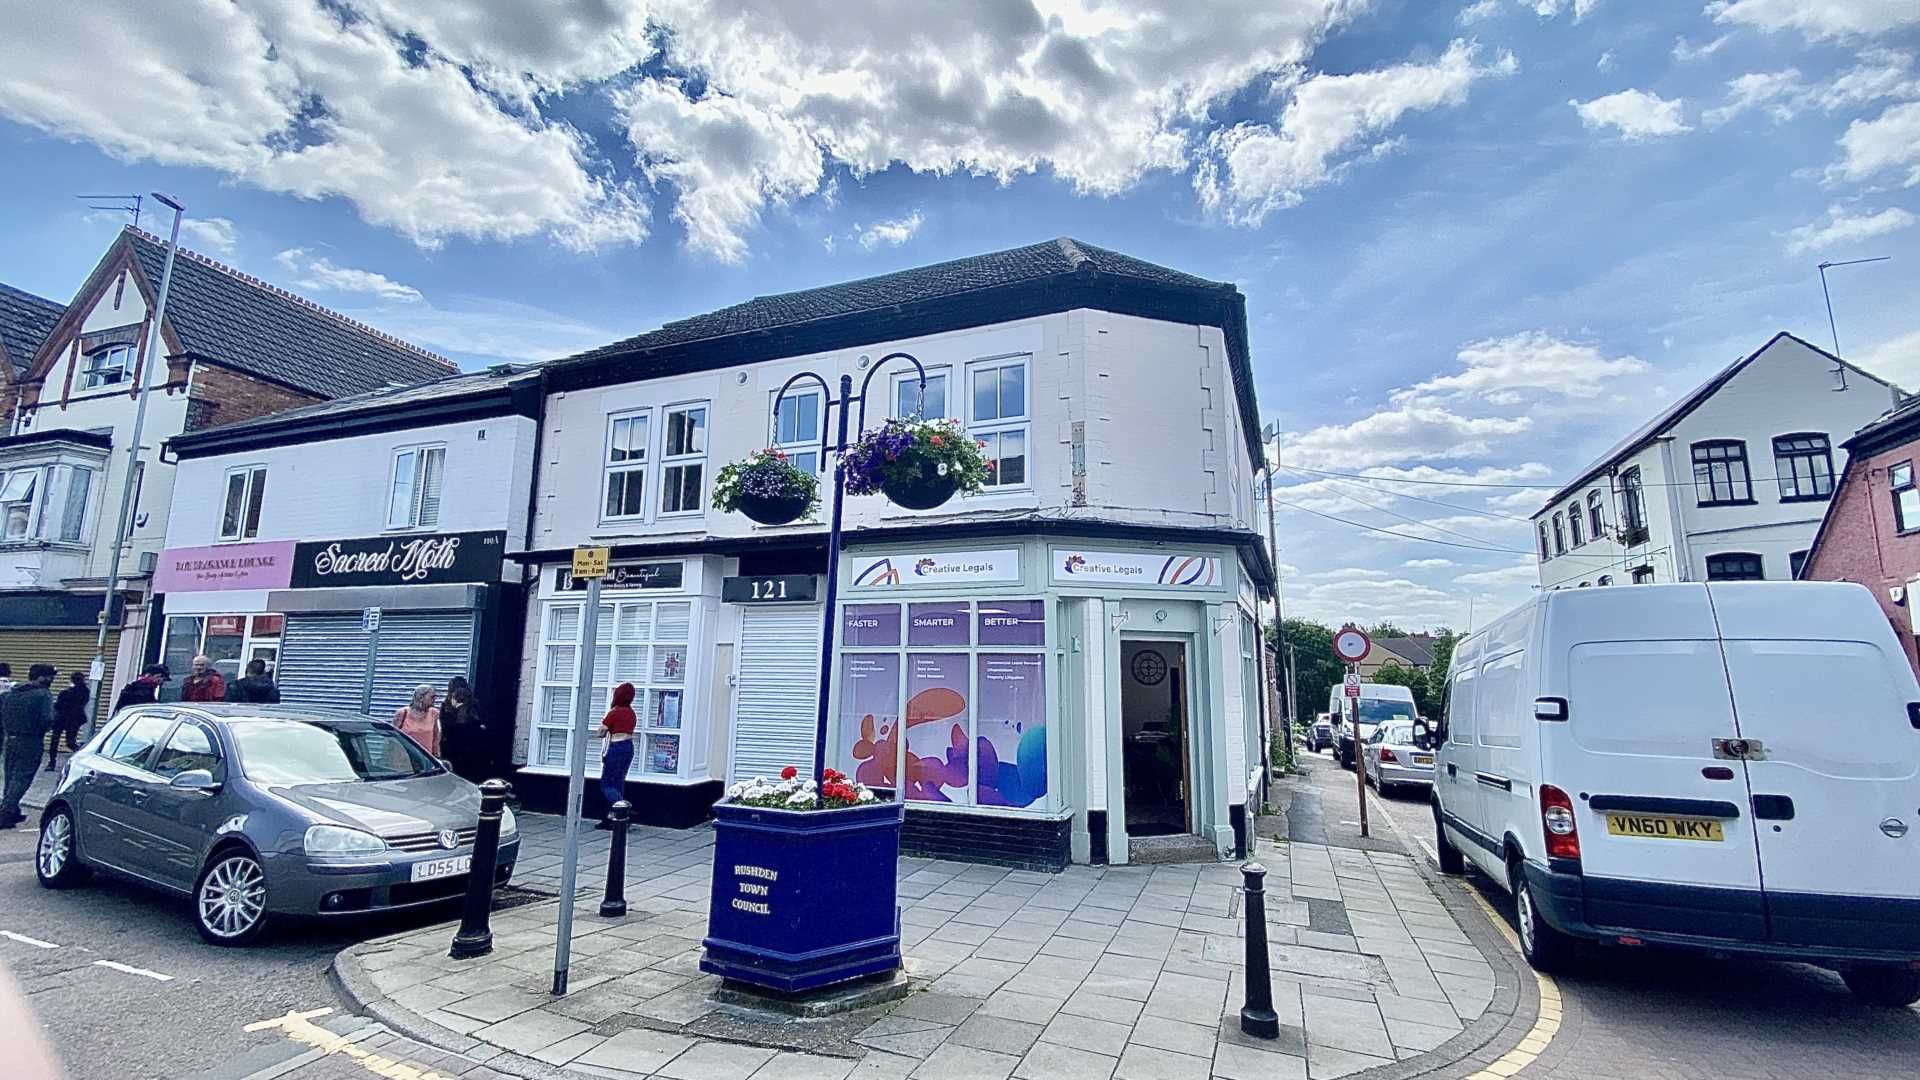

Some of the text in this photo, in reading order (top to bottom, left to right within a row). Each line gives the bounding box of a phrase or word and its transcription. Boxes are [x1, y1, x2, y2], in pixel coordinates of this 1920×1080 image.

[314, 537, 460, 581] Sacred Moth
[922, 562, 994, 574] Creative Legals
[1072, 563, 1143, 576] Creative Legals
[751, 580, 787, 599] 121
[848, 619, 879, 628] FASTER
[913, 618, 954, 627] SMARTER
[984, 617, 1019, 626] BETTER
[1615, 816, 1712, 838] VN60 WKY
[418, 861, 454, 878] LD55
[734, 865, 778, 881] RUSHDEN
[739, 882, 769, 896] TOWN
[732, 898, 771, 914] COUNCIL
